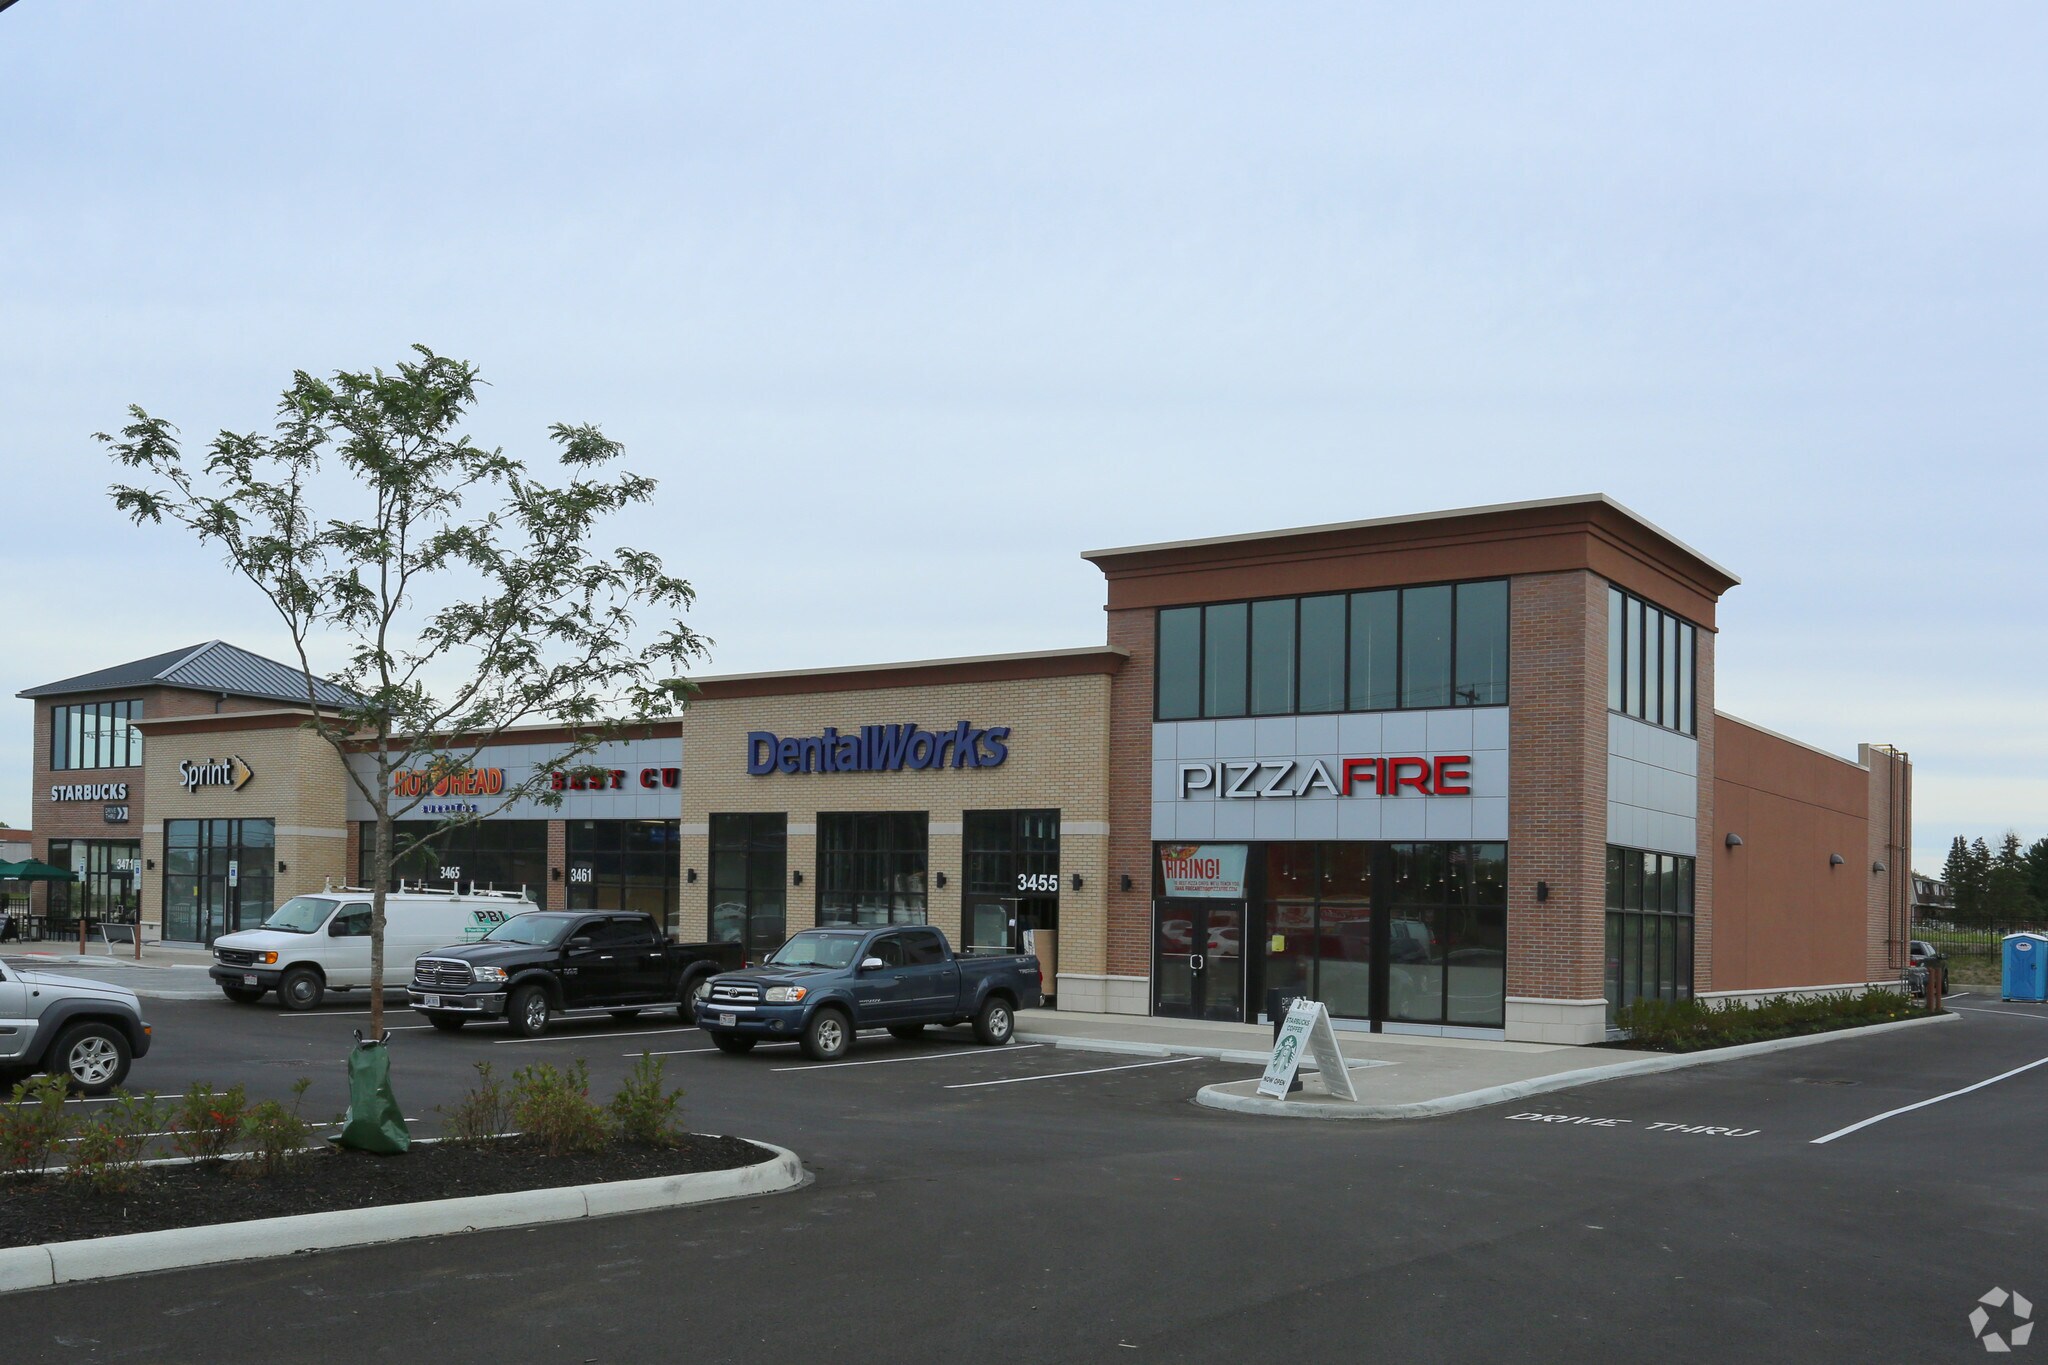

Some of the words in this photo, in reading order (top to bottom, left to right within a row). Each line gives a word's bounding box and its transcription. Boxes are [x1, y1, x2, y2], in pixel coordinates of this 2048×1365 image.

[747, 720, 1011, 776] DentalWorks
[179, 758, 234, 793] Sprint
[450, 767, 503, 795] HEAD
[550, 769, 624, 790] BEST
[1178, 755, 1471, 798] PIZZAFIRE
[51, 783, 128, 801] STARBUCKS
[421, 803, 477, 813] BURRITOS
[117, 859, 133, 870] 3471
[440, 867, 460, 879] 3465
[1166, 859, 1219, 879] HIRING!
[571, 868, 592, 882] 3461
[1017, 874, 1058, 891] 3455
[474, 911, 506, 922] PBI
[1286, 1016, 1310, 1026] STARBUCKS
[1286, 1025, 1303, 1034] COFFEE
[1274, 1078, 1286, 1086] OPEN
[1504, 1112, 1632, 1127] DRIVE
[1645, 1122, 1761, 1137] THRU
